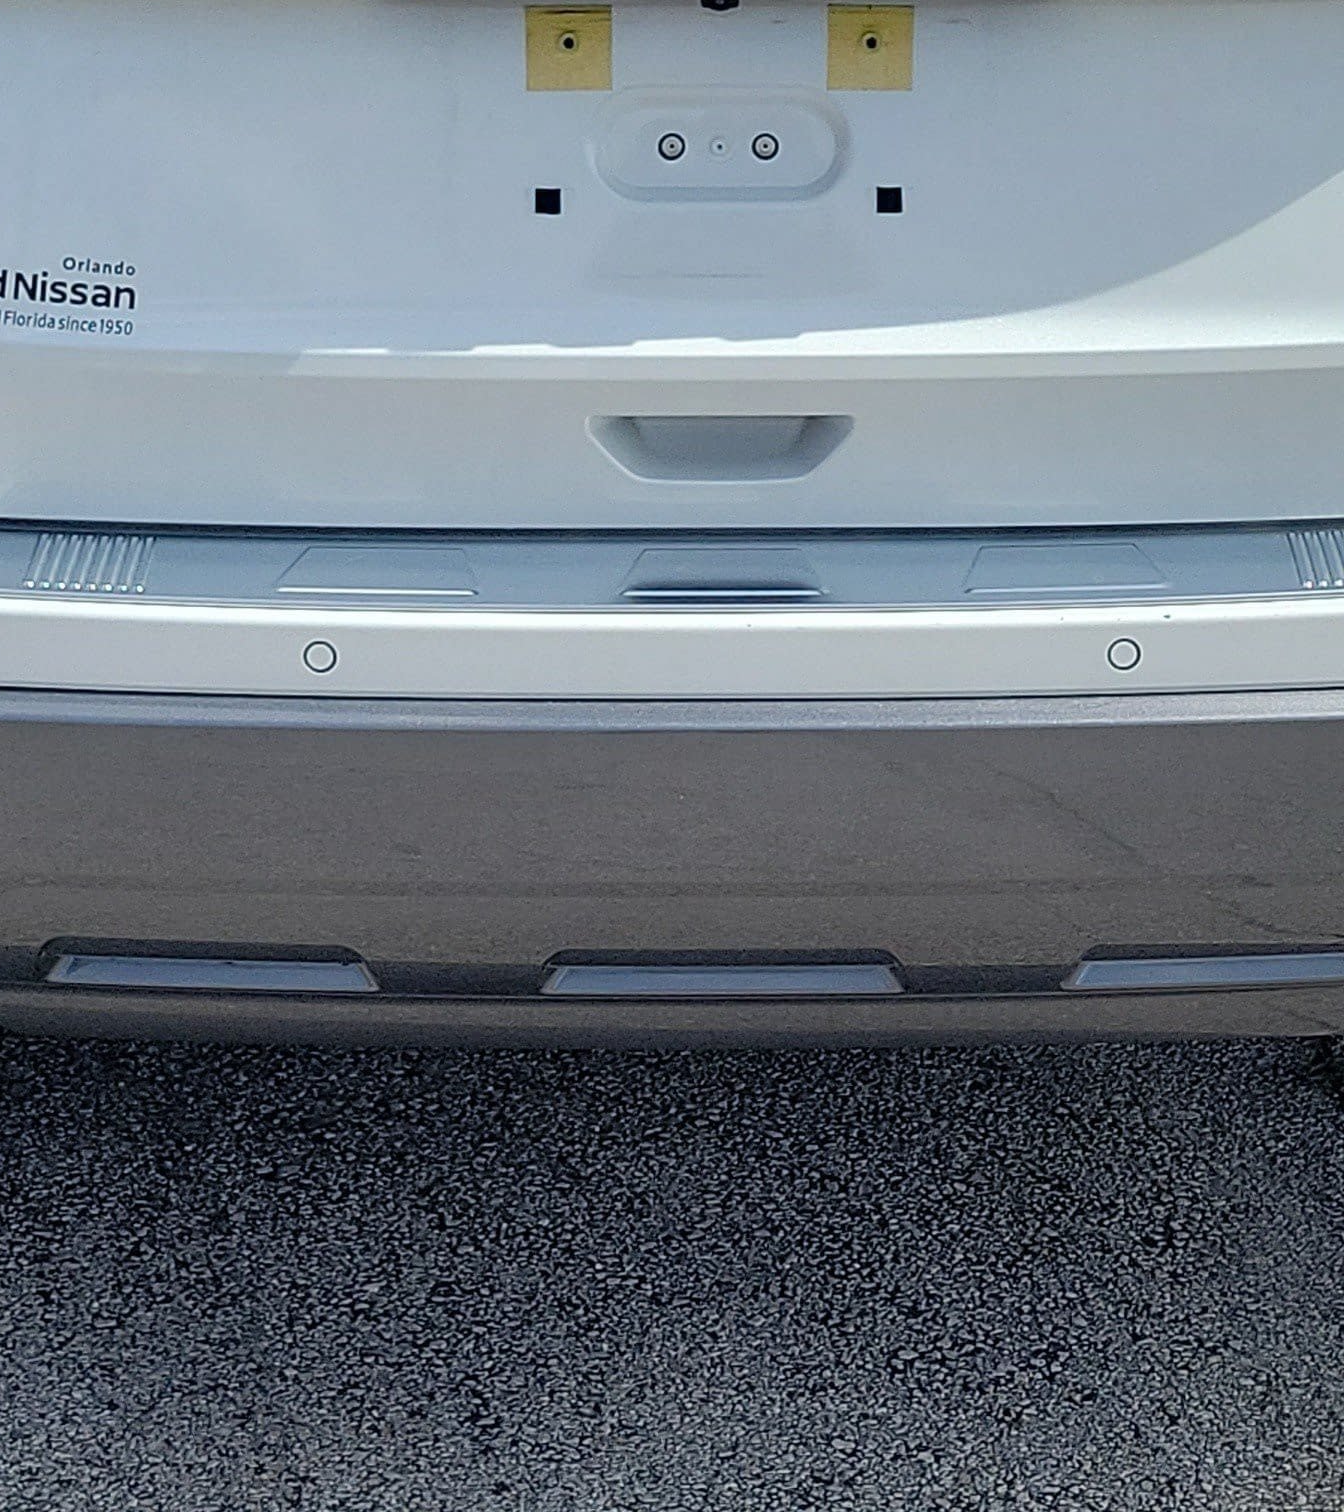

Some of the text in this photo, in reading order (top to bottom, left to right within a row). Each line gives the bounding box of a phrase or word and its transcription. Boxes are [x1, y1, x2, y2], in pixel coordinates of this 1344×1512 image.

[63, 257, 136, 277] Orlando
[13, 272, 136, 310] Nissan
[4, 311, 56, 330] Florida
[58, 315, 97, 333] since
[99, 319, 134, 336] 1950
